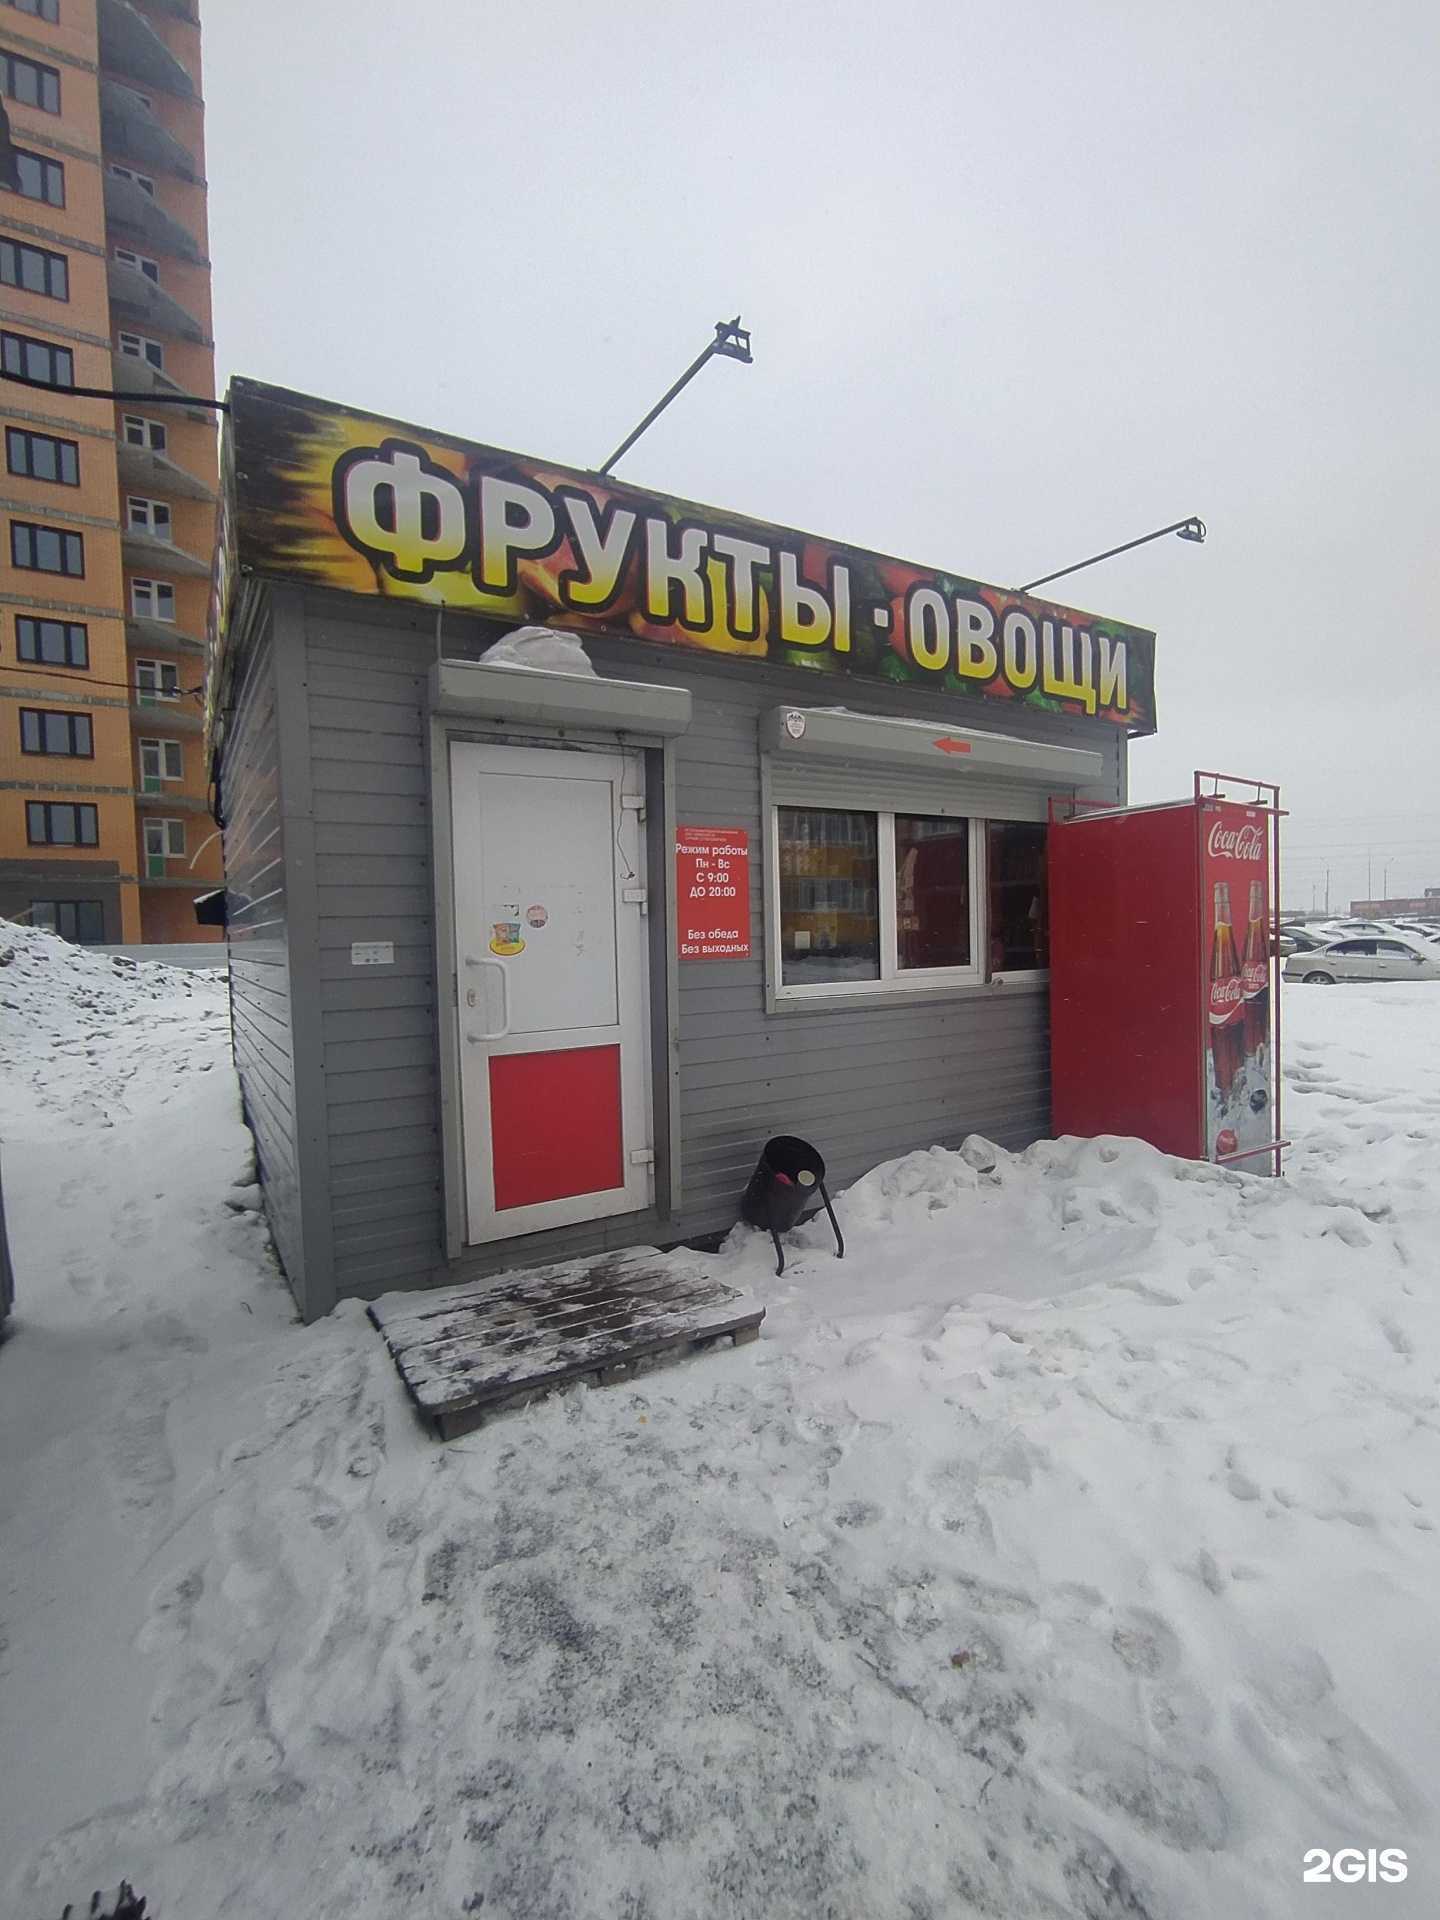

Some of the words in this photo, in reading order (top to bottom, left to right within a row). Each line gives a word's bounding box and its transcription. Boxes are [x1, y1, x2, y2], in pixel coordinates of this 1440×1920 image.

[345, 449, 851, 653] ФРУКТЫ
[909, 588, 1128, 715] ОВОЩИ
[675, 843, 709, 855] Режим
[712, 845, 748, 857] работы
[696, 858, 709, 868] Пн
[718, 858, 731, 869] Вс
[696, 872, 705, 882] С
[707, 872, 729, 883] 9:00
[689, 886, 706, 898] ДО
[708, 886, 736, 897] 20:00
[687, 929, 706, 940] Без
[708, 928, 739, 939] обеда
[681, 943, 700, 954] Без
[702, 944, 749, 953] выходных
